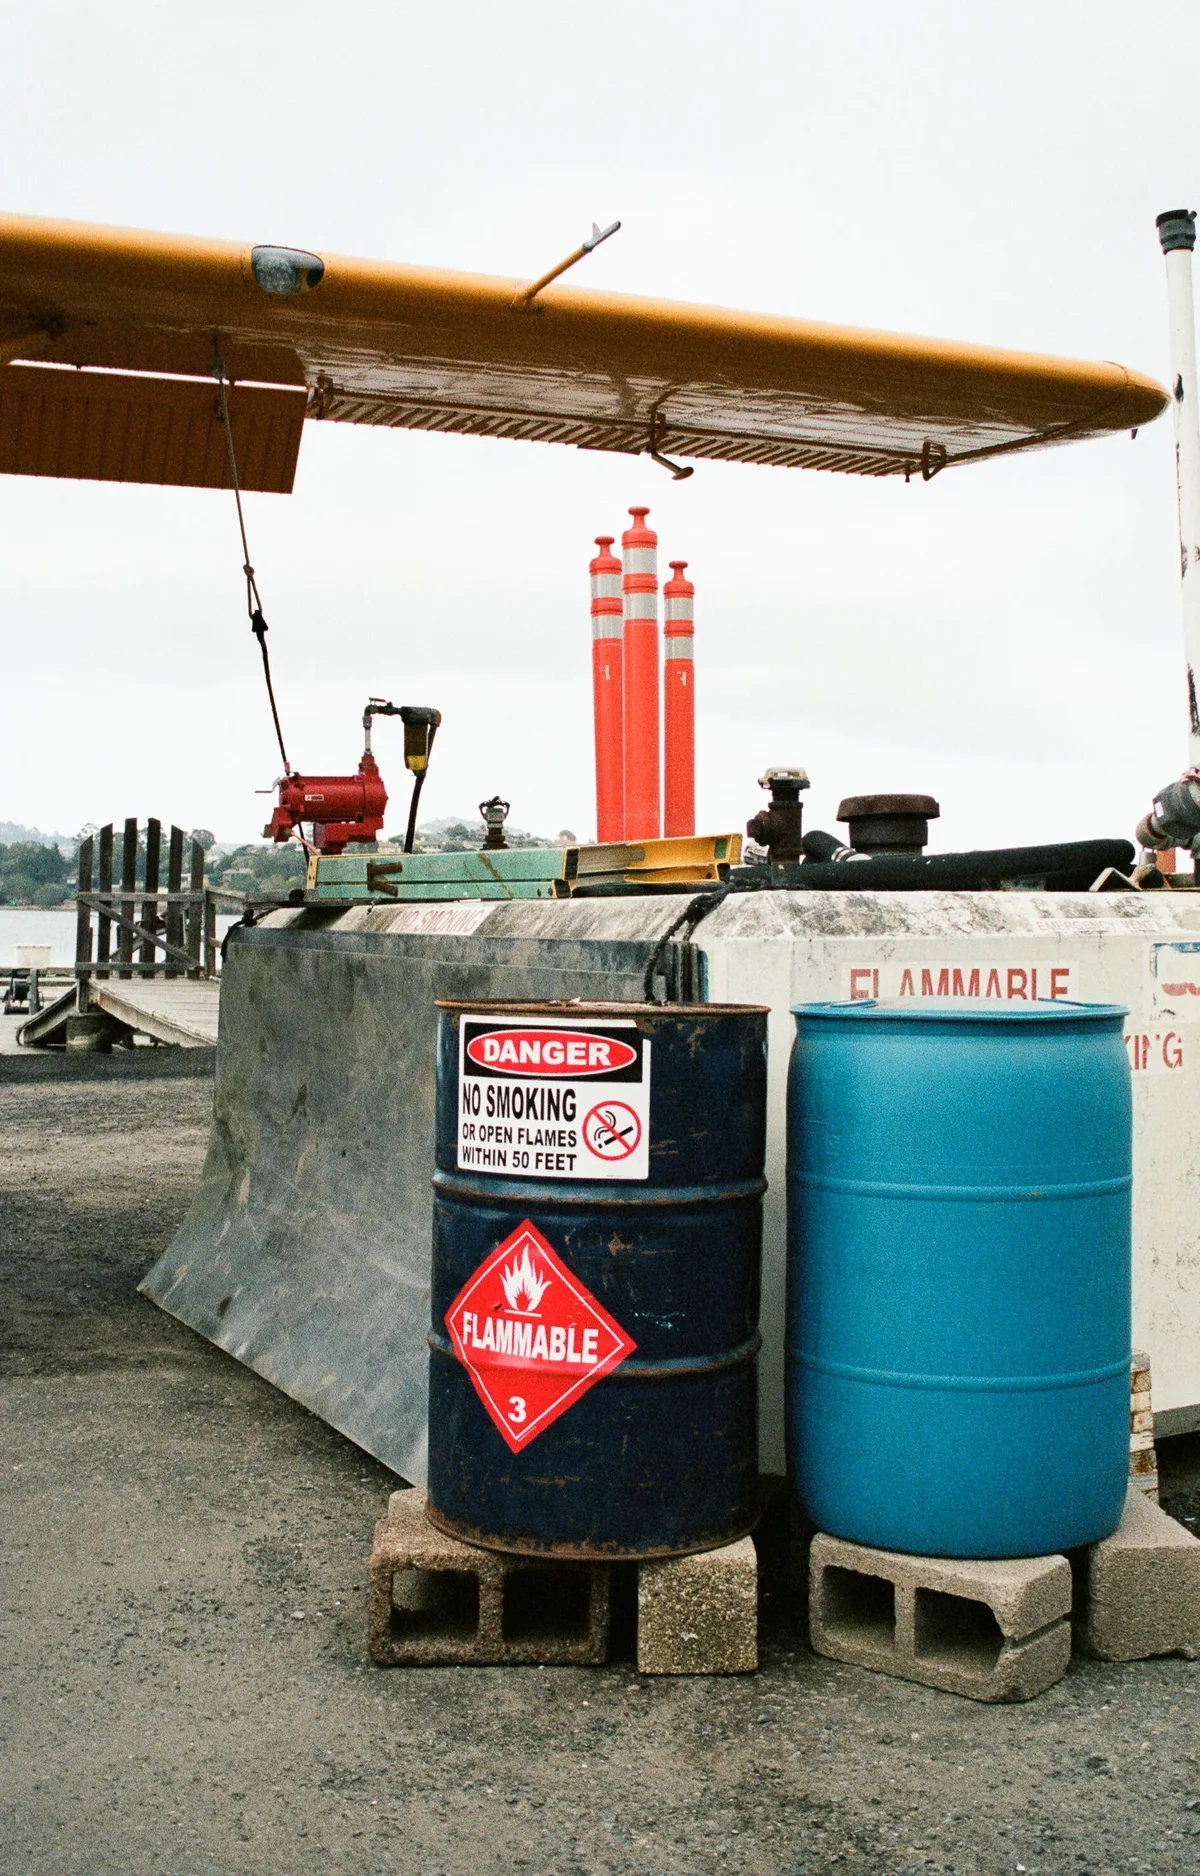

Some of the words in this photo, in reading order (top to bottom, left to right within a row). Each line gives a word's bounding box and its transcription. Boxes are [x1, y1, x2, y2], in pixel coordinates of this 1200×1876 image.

[414, 910, 484, 932] SMOKING
[483, 1038, 612, 1066] DANGER
[1124, 1032, 1182, 1070] ING
[462, 1083, 481, 1116] NO
[486, 1084, 577, 1122] SMOKING
[462, 1123, 476, 1140] OR
[478, 1124, 513, 1144] OPEN
[517, 1127, 577, 1148] FLAMES
[462, 1145, 507, 1167] WITHIN
[512, 1152, 530, 1169] 50
[535, 1152, 577, 1171] FEET
[462, 1310, 600, 1364] FLAMMABLE
[507, 1396, 527, 1423] 3
